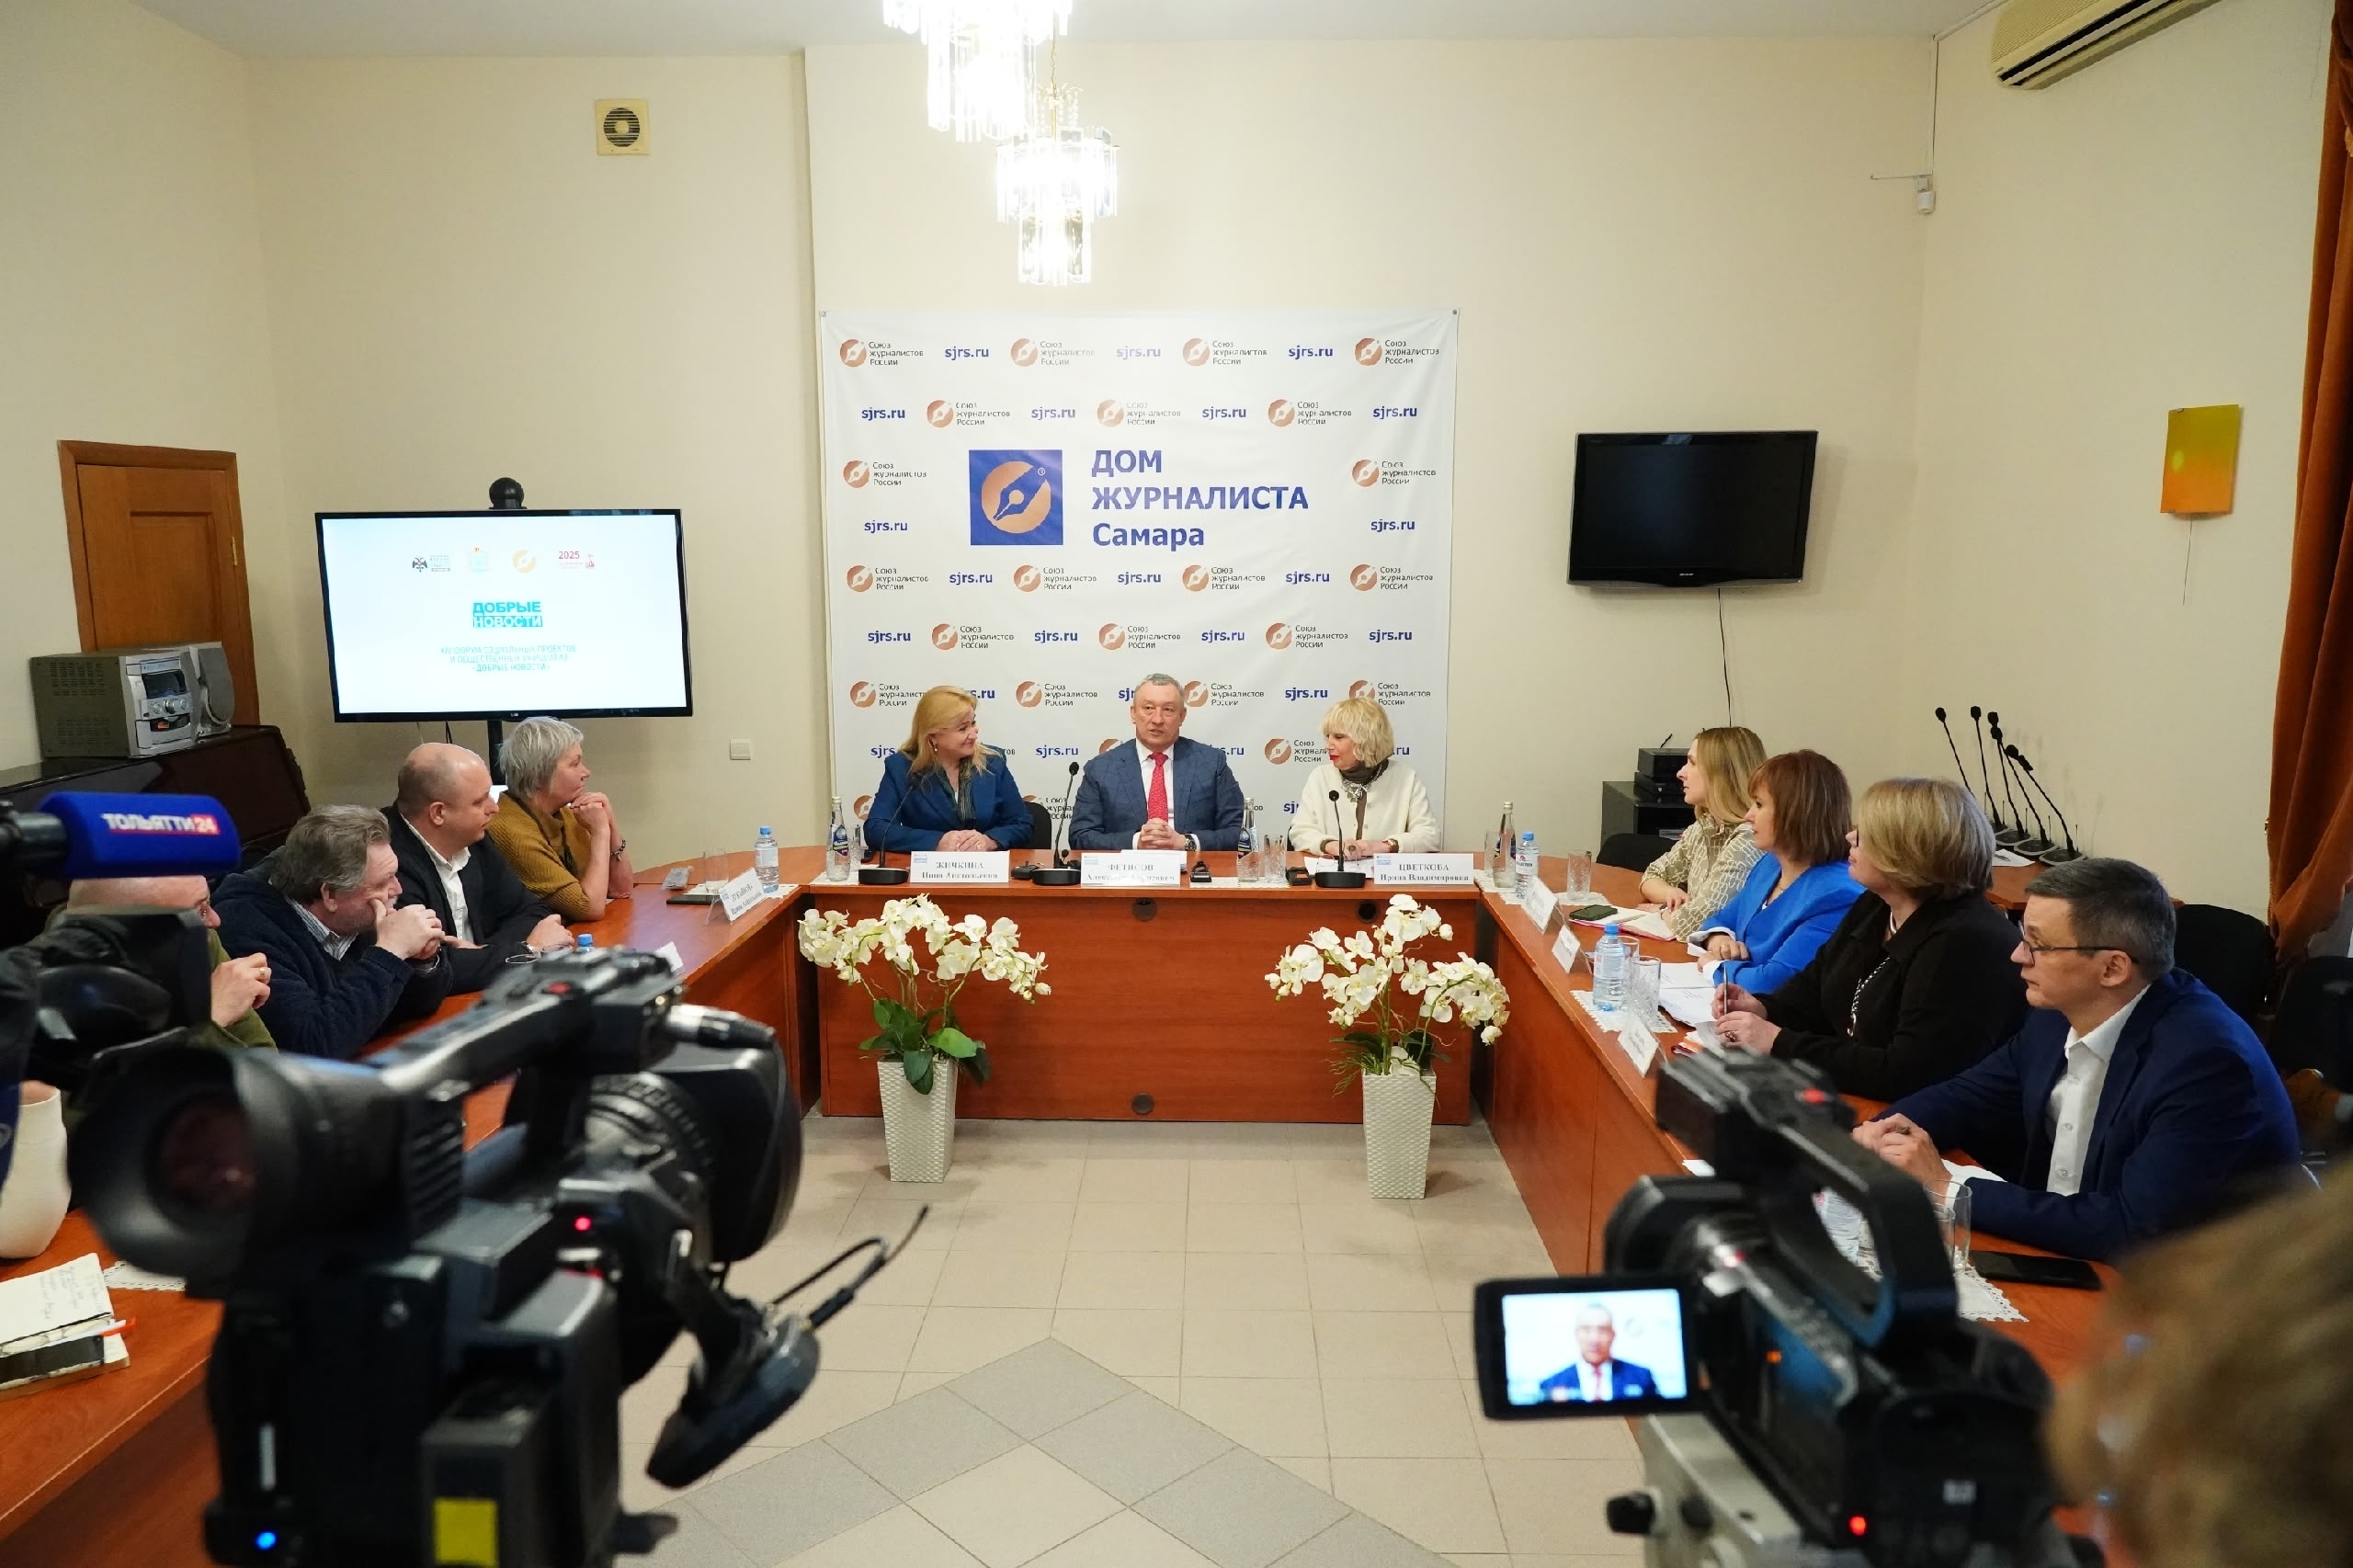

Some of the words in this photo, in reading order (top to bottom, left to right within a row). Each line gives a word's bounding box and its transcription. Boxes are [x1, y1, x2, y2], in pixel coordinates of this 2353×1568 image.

[869, 341, 891, 349] Союз
[945, 347, 989, 360] sjrs.ru
[1116, 347, 1161, 360] sjrs.ru
[1289, 346, 1333, 359] sjrs.ru
[861, 407, 905, 421] sjrs.ru
[1031, 407, 1075, 420] sjrs.ru
[1202, 407, 1246, 420] sjrs.ru
[1373, 406, 1417, 420] sjrs.ru
[1091, 449, 1162, 477] ДОМ
[1092, 486, 1309, 510] ЖУРНАЛИСТА
[864, 520, 908, 533] sjrs.ru
[1370, 518, 1415, 532] sjrs.ru
[1093, 523, 1205, 551] Самара
[559, 551, 580, 560] 2025
[949, 572, 993, 585] sjrs.ru
[1118, 572, 1161, 585] sjrs.ru
[1286, 571, 1330, 585] sjrs.ru
[473, 602, 541, 615] ДОБРЫЕ
[473, 616, 542, 627] НОВОСТИ
[868, 631, 911, 643] sjrs.ru
[1034, 631, 1078, 643] sjrs.ru
[1201, 630, 1245, 643] sjrs.ru
[1369, 630, 1413, 642] sjrs.ru
[1285, 687, 1328, 700] sjrs.ru
[870, 744, 895, 758] sjrs
[1036, 744, 1078, 758] sjrs.ru
